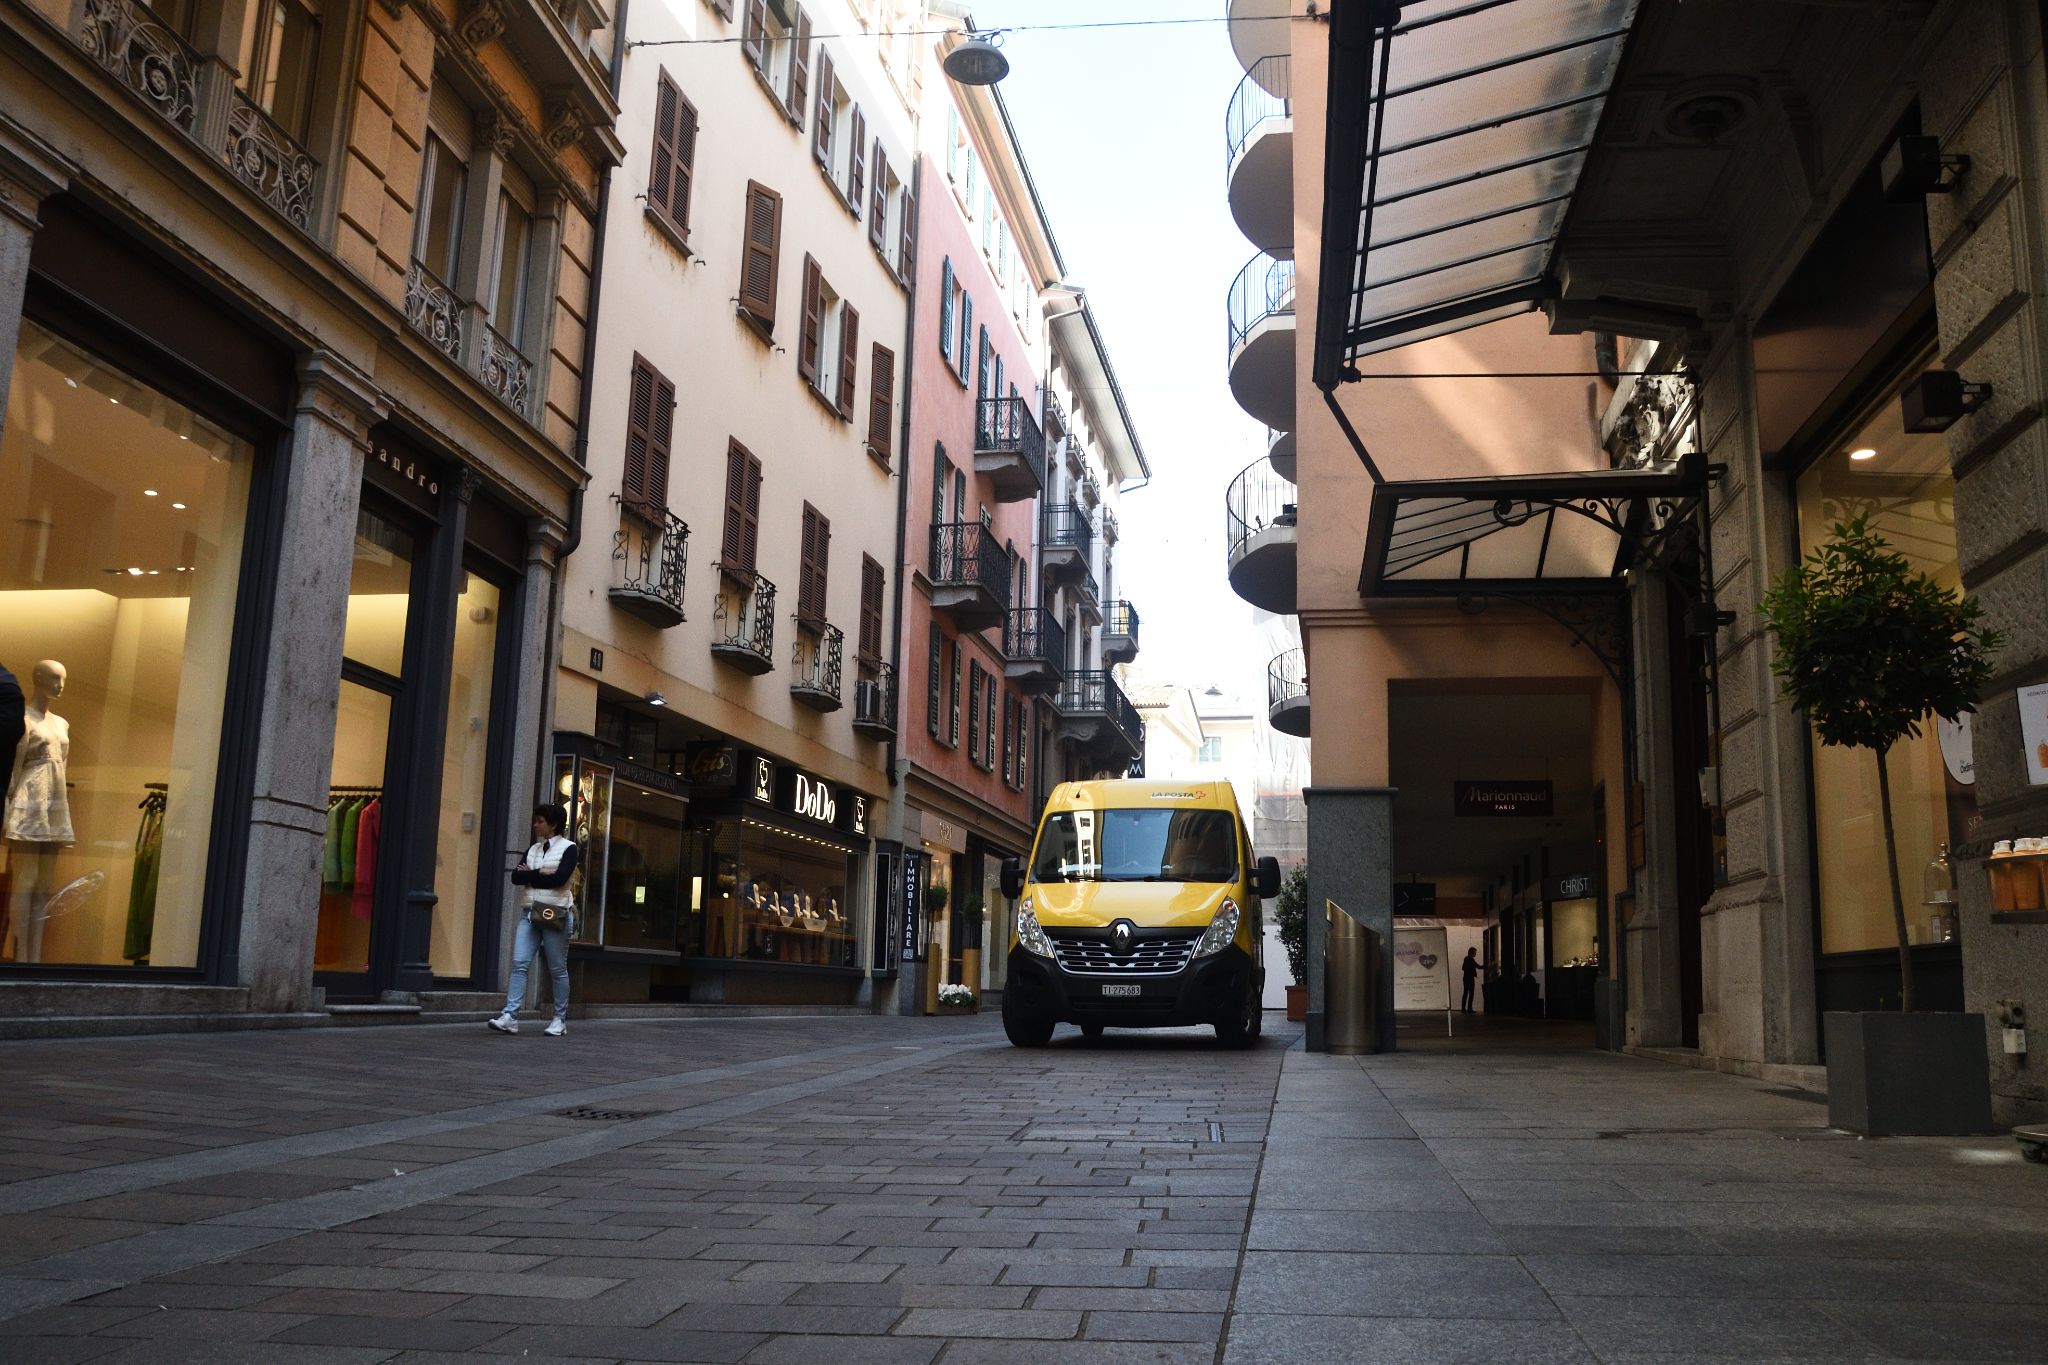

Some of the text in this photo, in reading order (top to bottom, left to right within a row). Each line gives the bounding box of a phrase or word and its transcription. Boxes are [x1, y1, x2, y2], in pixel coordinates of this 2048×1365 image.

[367, 440, 438, 494] sandro
[794, 773, 836, 823] DoDo
[1463, 786, 1547, 803] Marionnaud
[905, 859, 915, 947] IMMOBILIARE
[1560, 877, 1589, 894] CHRIST
